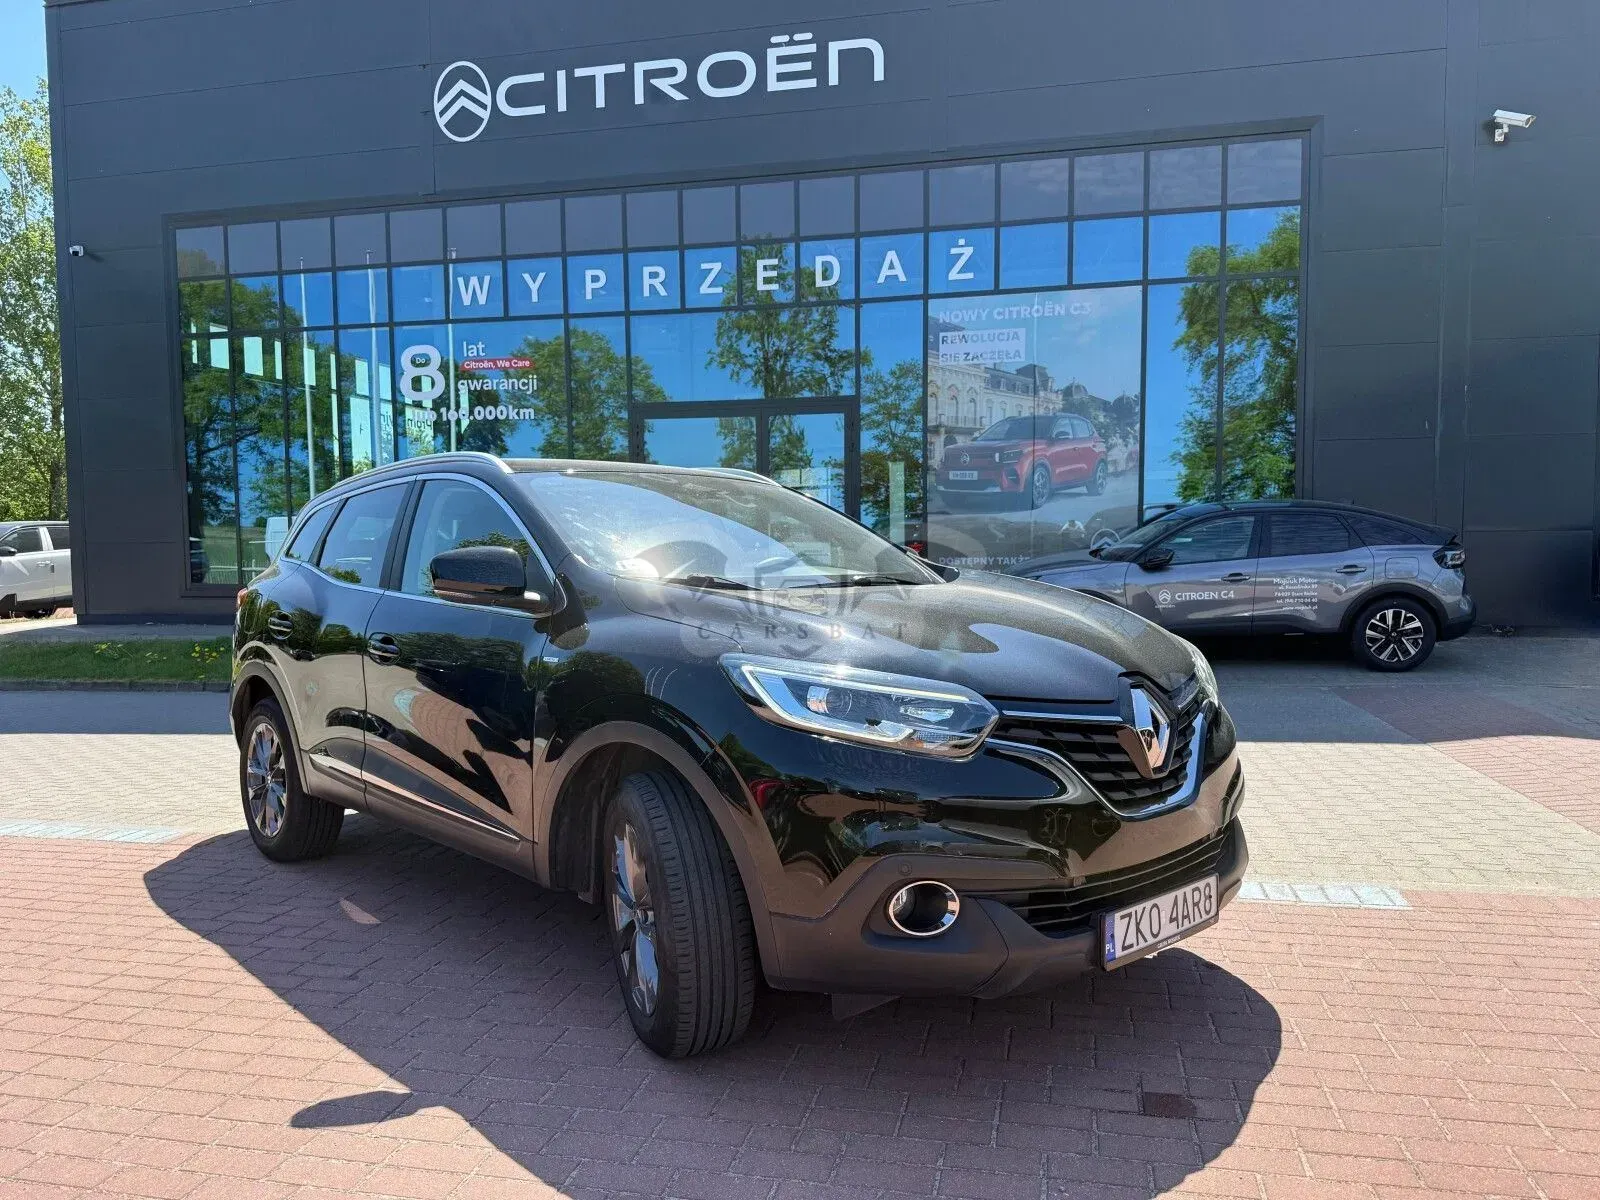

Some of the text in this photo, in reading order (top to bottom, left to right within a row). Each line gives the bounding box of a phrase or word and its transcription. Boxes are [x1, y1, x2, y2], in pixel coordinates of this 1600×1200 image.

[496, 32, 885, 117] CITROËN
[938, 301, 1092, 323] NOWY CITROËN C3
[941, 331, 1021, 345] REWOLUCJA
[463, 341, 486, 357] lat
[400, 344, 446, 401] 8
[464, 359, 530, 370] Citroën, We Care
[457, 375, 538, 394] gwarancji
[1175, 590, 1235, 601] CITROEN C4
[1120, 882, 1213, 952] ZKO 4AR8
[1105, 943, 1115, 954] PL
